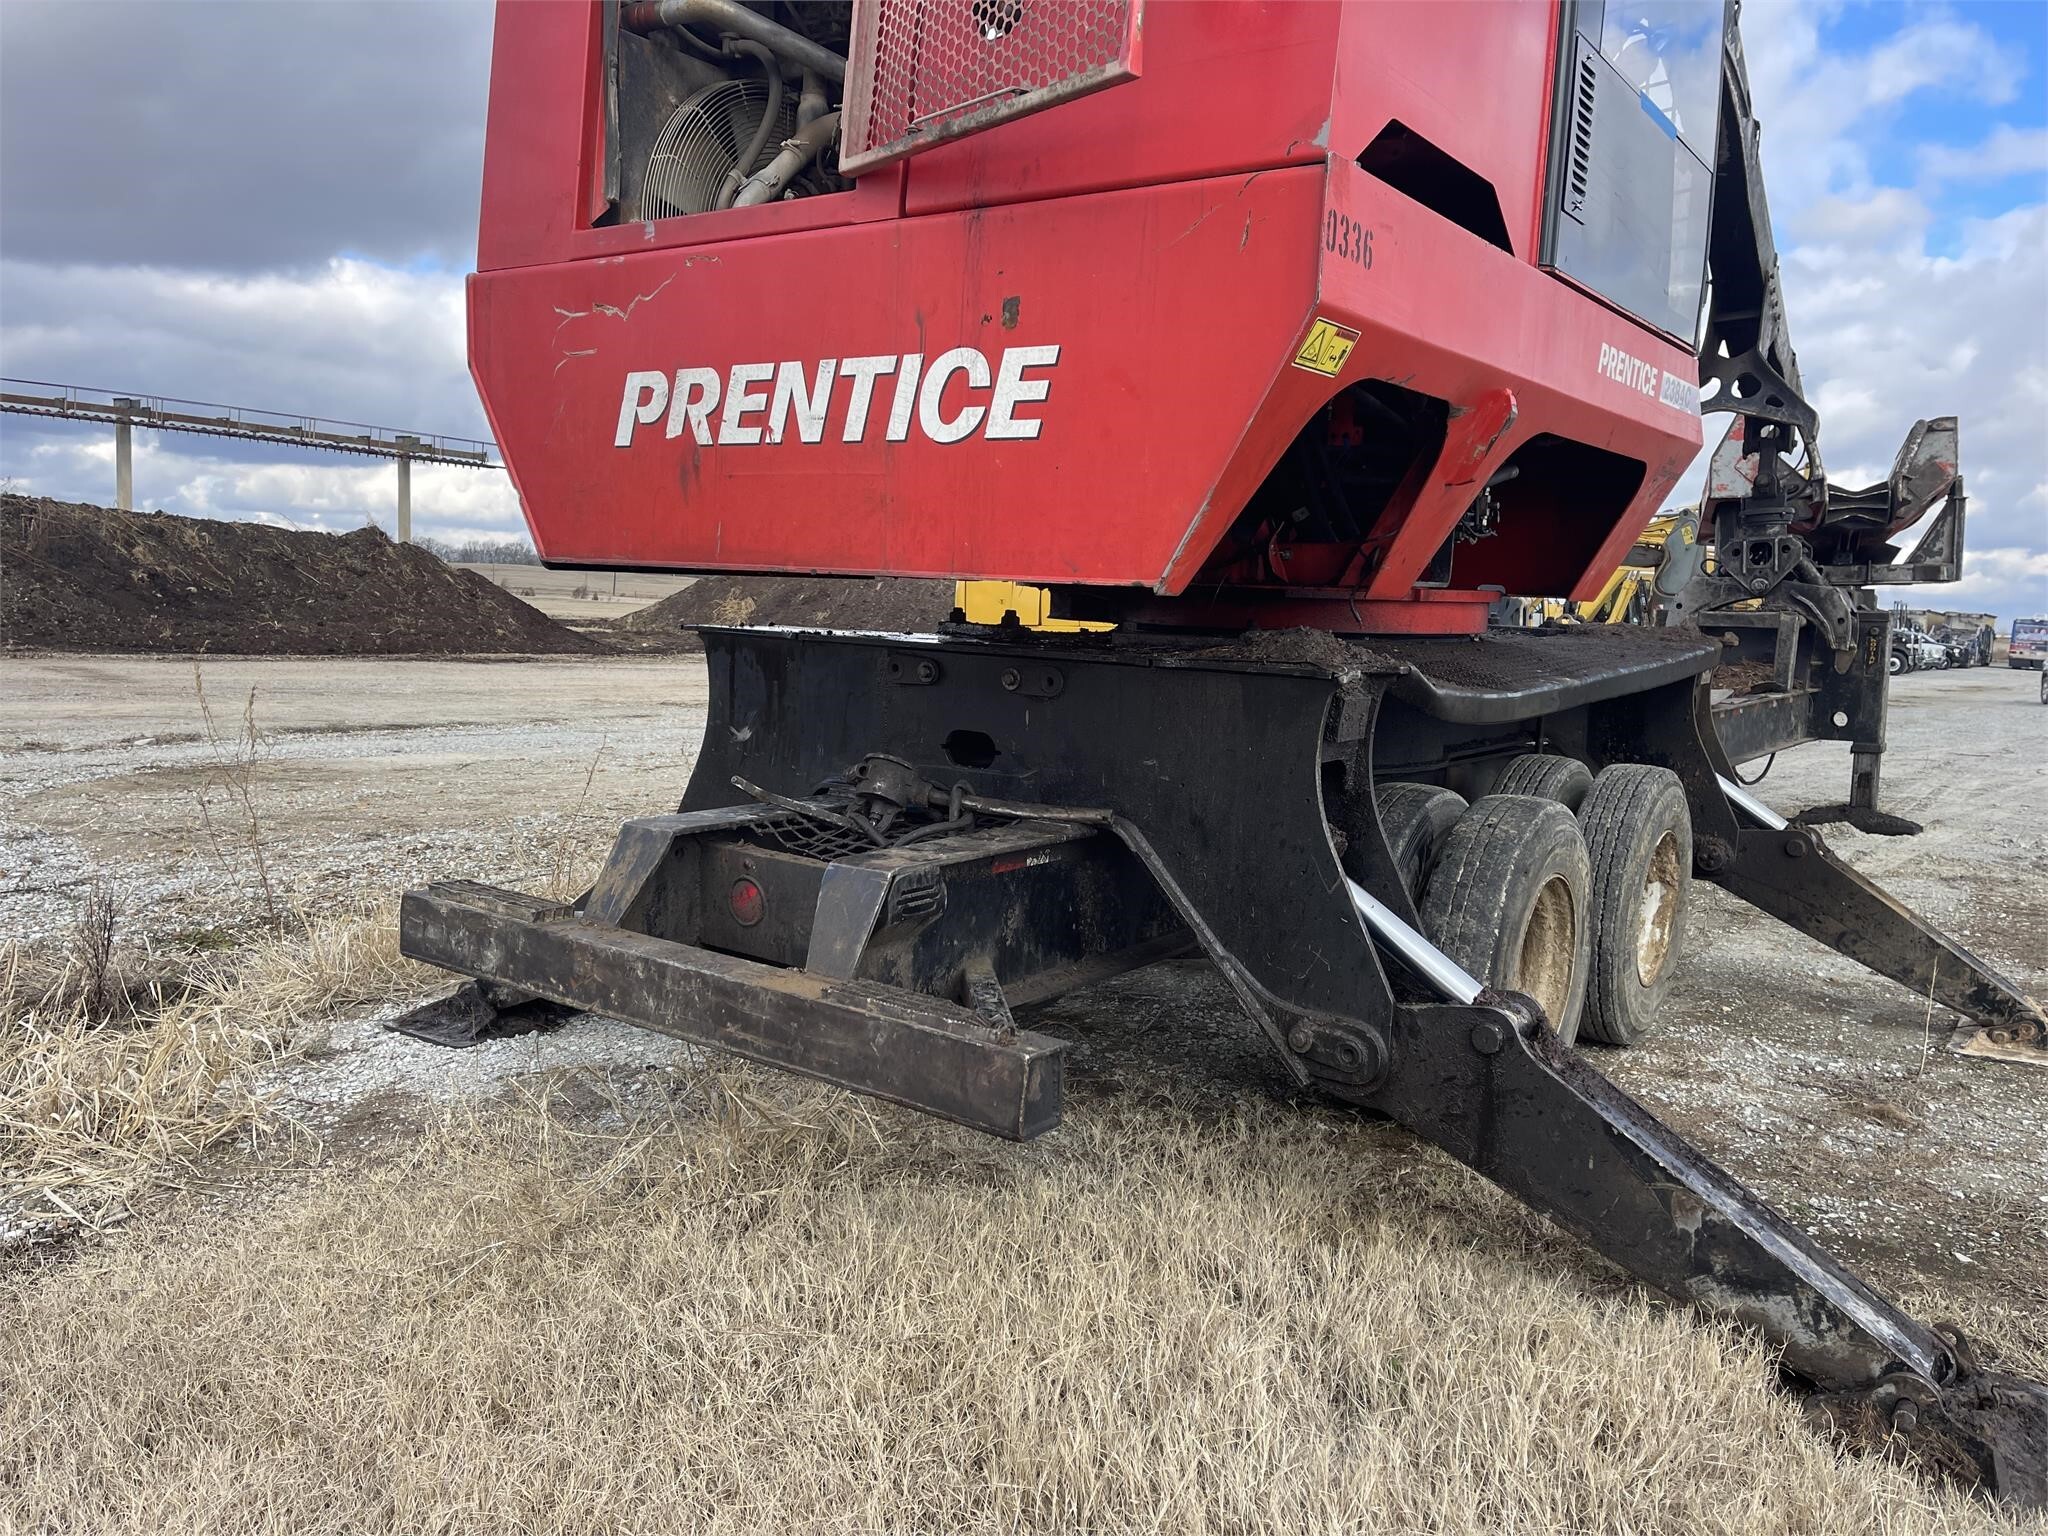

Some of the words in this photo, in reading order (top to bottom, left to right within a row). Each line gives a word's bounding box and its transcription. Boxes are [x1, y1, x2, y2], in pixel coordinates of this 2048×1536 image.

[1325, 208, 1374, 271] 0336
[614, 344, 1061, 447] PRENTICE
[1597, 341, 1659, 398] PRENTICE
